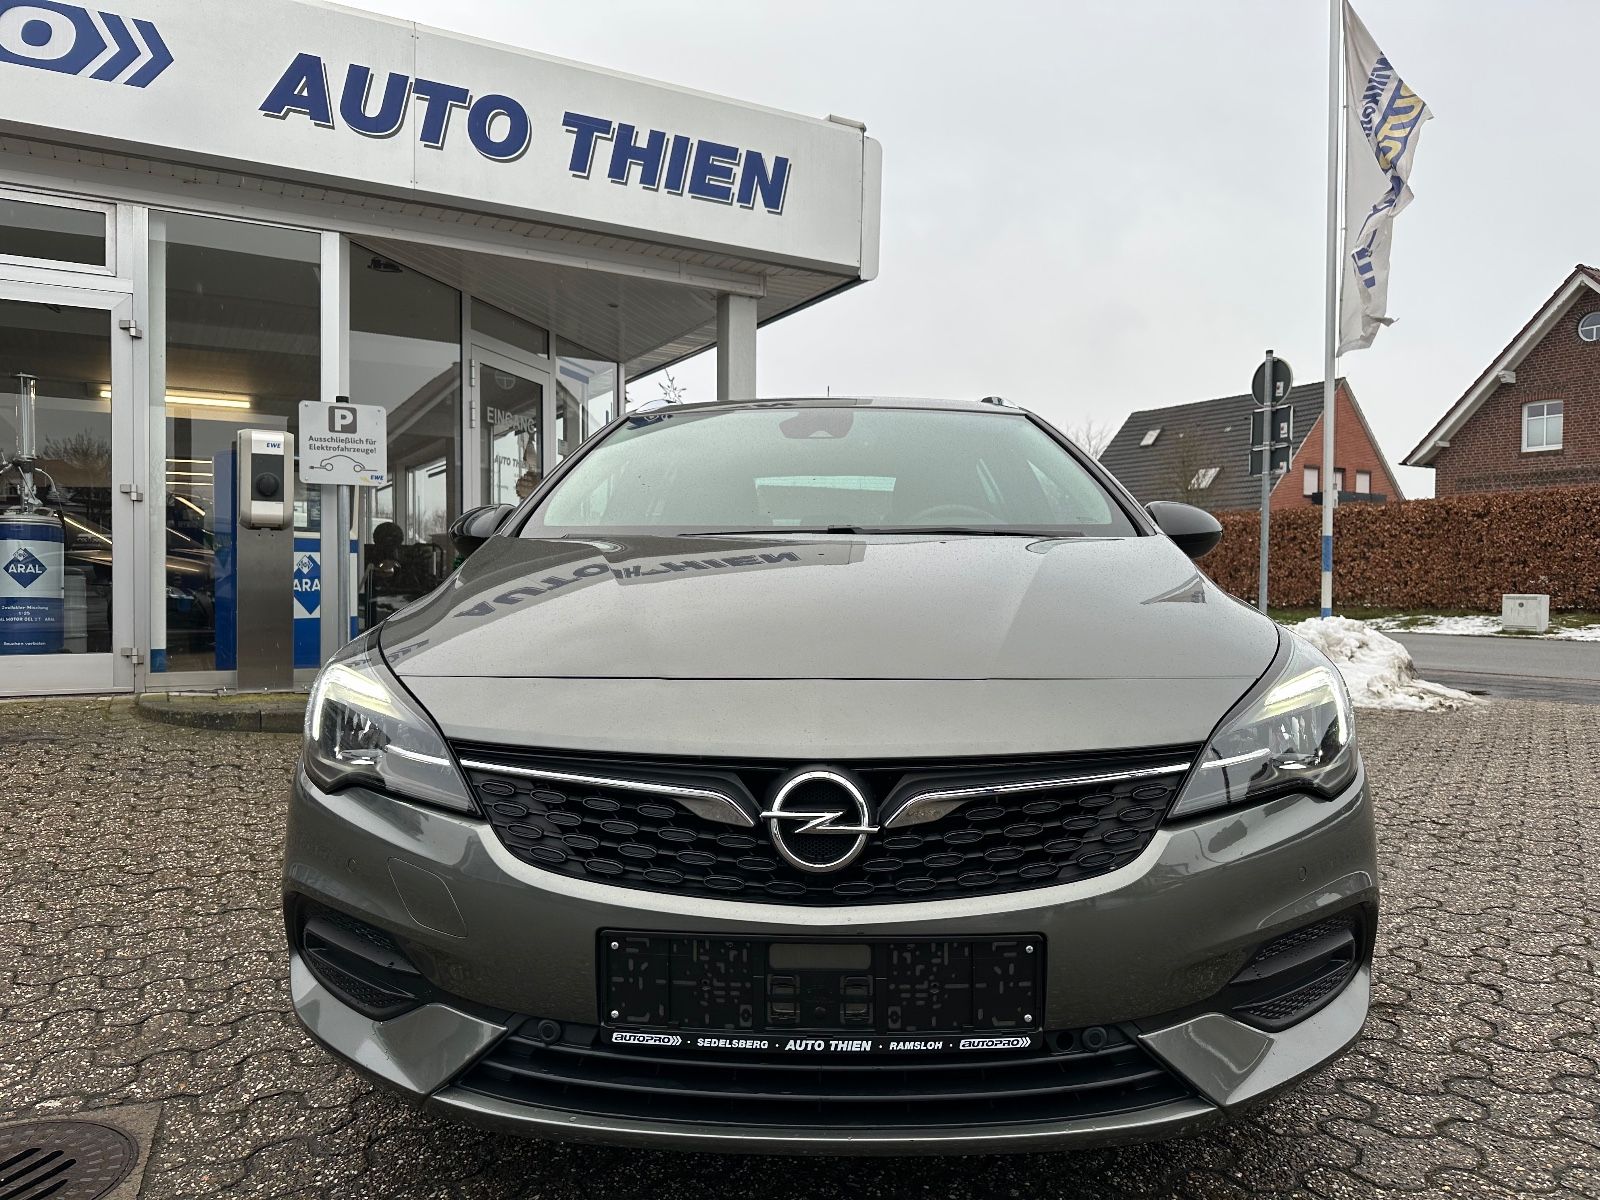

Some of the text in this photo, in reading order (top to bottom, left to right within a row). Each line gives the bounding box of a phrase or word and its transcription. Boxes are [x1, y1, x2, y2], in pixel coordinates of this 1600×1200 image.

[258, 52, 792, 213] AUTO THIEN
[334, 408, 354, 431] P
[487, 406, 536, 434] EINGANG
[308, 435, 377, 446] Ausschließlich für
[308, 443, 377, 455] Elektrofahrzeuge!
[8, 563, 43, 574] ARAL
[697, 1038, 769, 1049] SEDELSBERG
[785, 1040, 825, 1051] AUTO
[829, 1040, 872, 1051] THIEN
[889, 1041, 943, 1050] RAMSLOH
